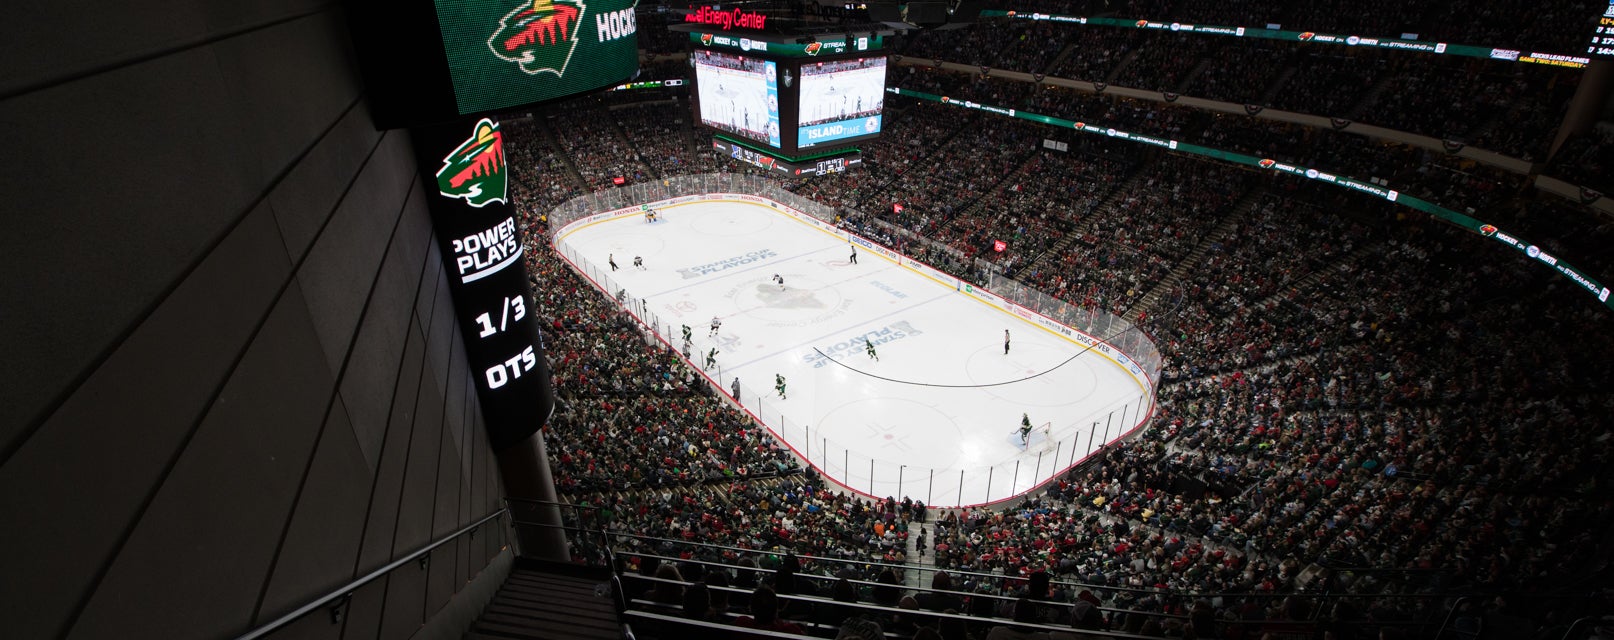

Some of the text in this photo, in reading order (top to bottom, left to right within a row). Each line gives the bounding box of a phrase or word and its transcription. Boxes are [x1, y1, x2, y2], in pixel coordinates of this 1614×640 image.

[705, 6, 732, 30] Energy
[734, 8, 766, 29] Center
[808, 125, 843, 139] ISLAND
[844, 126, 860, 136] TIME
[1346, 181, 1380, 195] STREAMING
[614, 207, 640, 216] HONDA
[852, 236, 872, 249] GEICO
[876, 246, 896, 259] DISCOVER
[457, 235, 517, 274] PLAYS
[691, 249, 769, 272] STANLEY CUP
[701, 252, 777, 275] PLAYOFFS
[1496, 232, 1518, 246] HOCKEY
[1538, 252, 1557, 266] NORTH
[1564, 268, 1596, 291] STREAMING
[476, 294, 526, 338] 1/3
[802, 327, 892, 363] PLAYOFFS
[1077, 334, 1110, 353] DISCOVER
[486, 345, 536, 389] OTS
